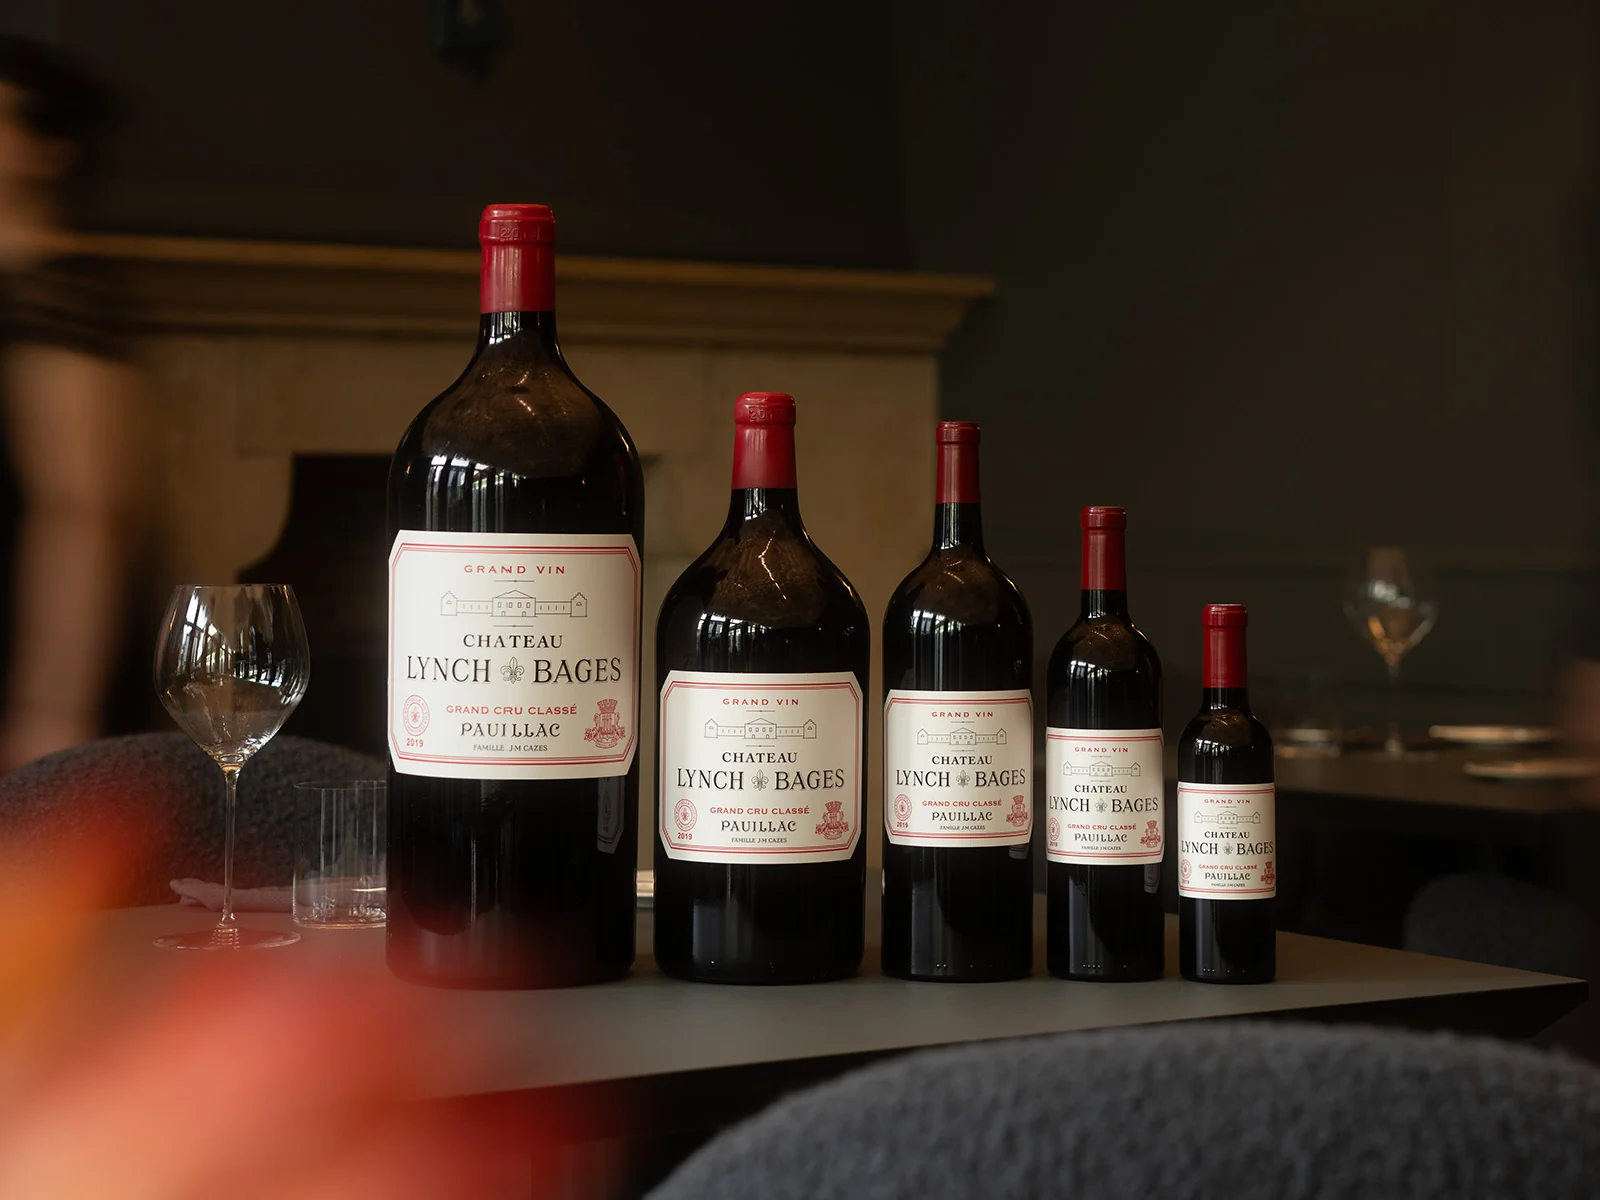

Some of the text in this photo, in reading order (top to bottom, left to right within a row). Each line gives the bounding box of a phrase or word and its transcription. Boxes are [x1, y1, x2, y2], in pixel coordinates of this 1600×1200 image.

[464, 565, 565, 574] GRAND VIN
[463, 634, 563, 648] CHATEAU
[407, 656, 621, 684] LYNCH BAGES
[446, 704, 577, 715] GRAND CRU CLASSÉ
[460, 722, 560, 738] PAUILLAC
[406, 738, 424, 748] 2019
[722, 752, 797, 763] CHATEAU
[932, 756, 993, 765] CHATEAU
[677, 768, 845, 791] LYNCH BAGES
[896, 769, 1026, 787] LYNCH BAGES
[1074, 785, 1127, 793] CHATEAU
[973, 799, 1002, 807] CLASSÉ
[1050, 796, 1158, 812] LYNCH BAGES
[772, 805, 810, 815] CLASSÉ
[932, 811, 993, 821] PAUILLAC
[721, 820, 796, 832] PAUILLAC
[677, 832, 692, 840] 2019
[1075, 833, 1128, 842] PAUILLAC
[1181, 840, 1273, 855] LYNCH BAGES
